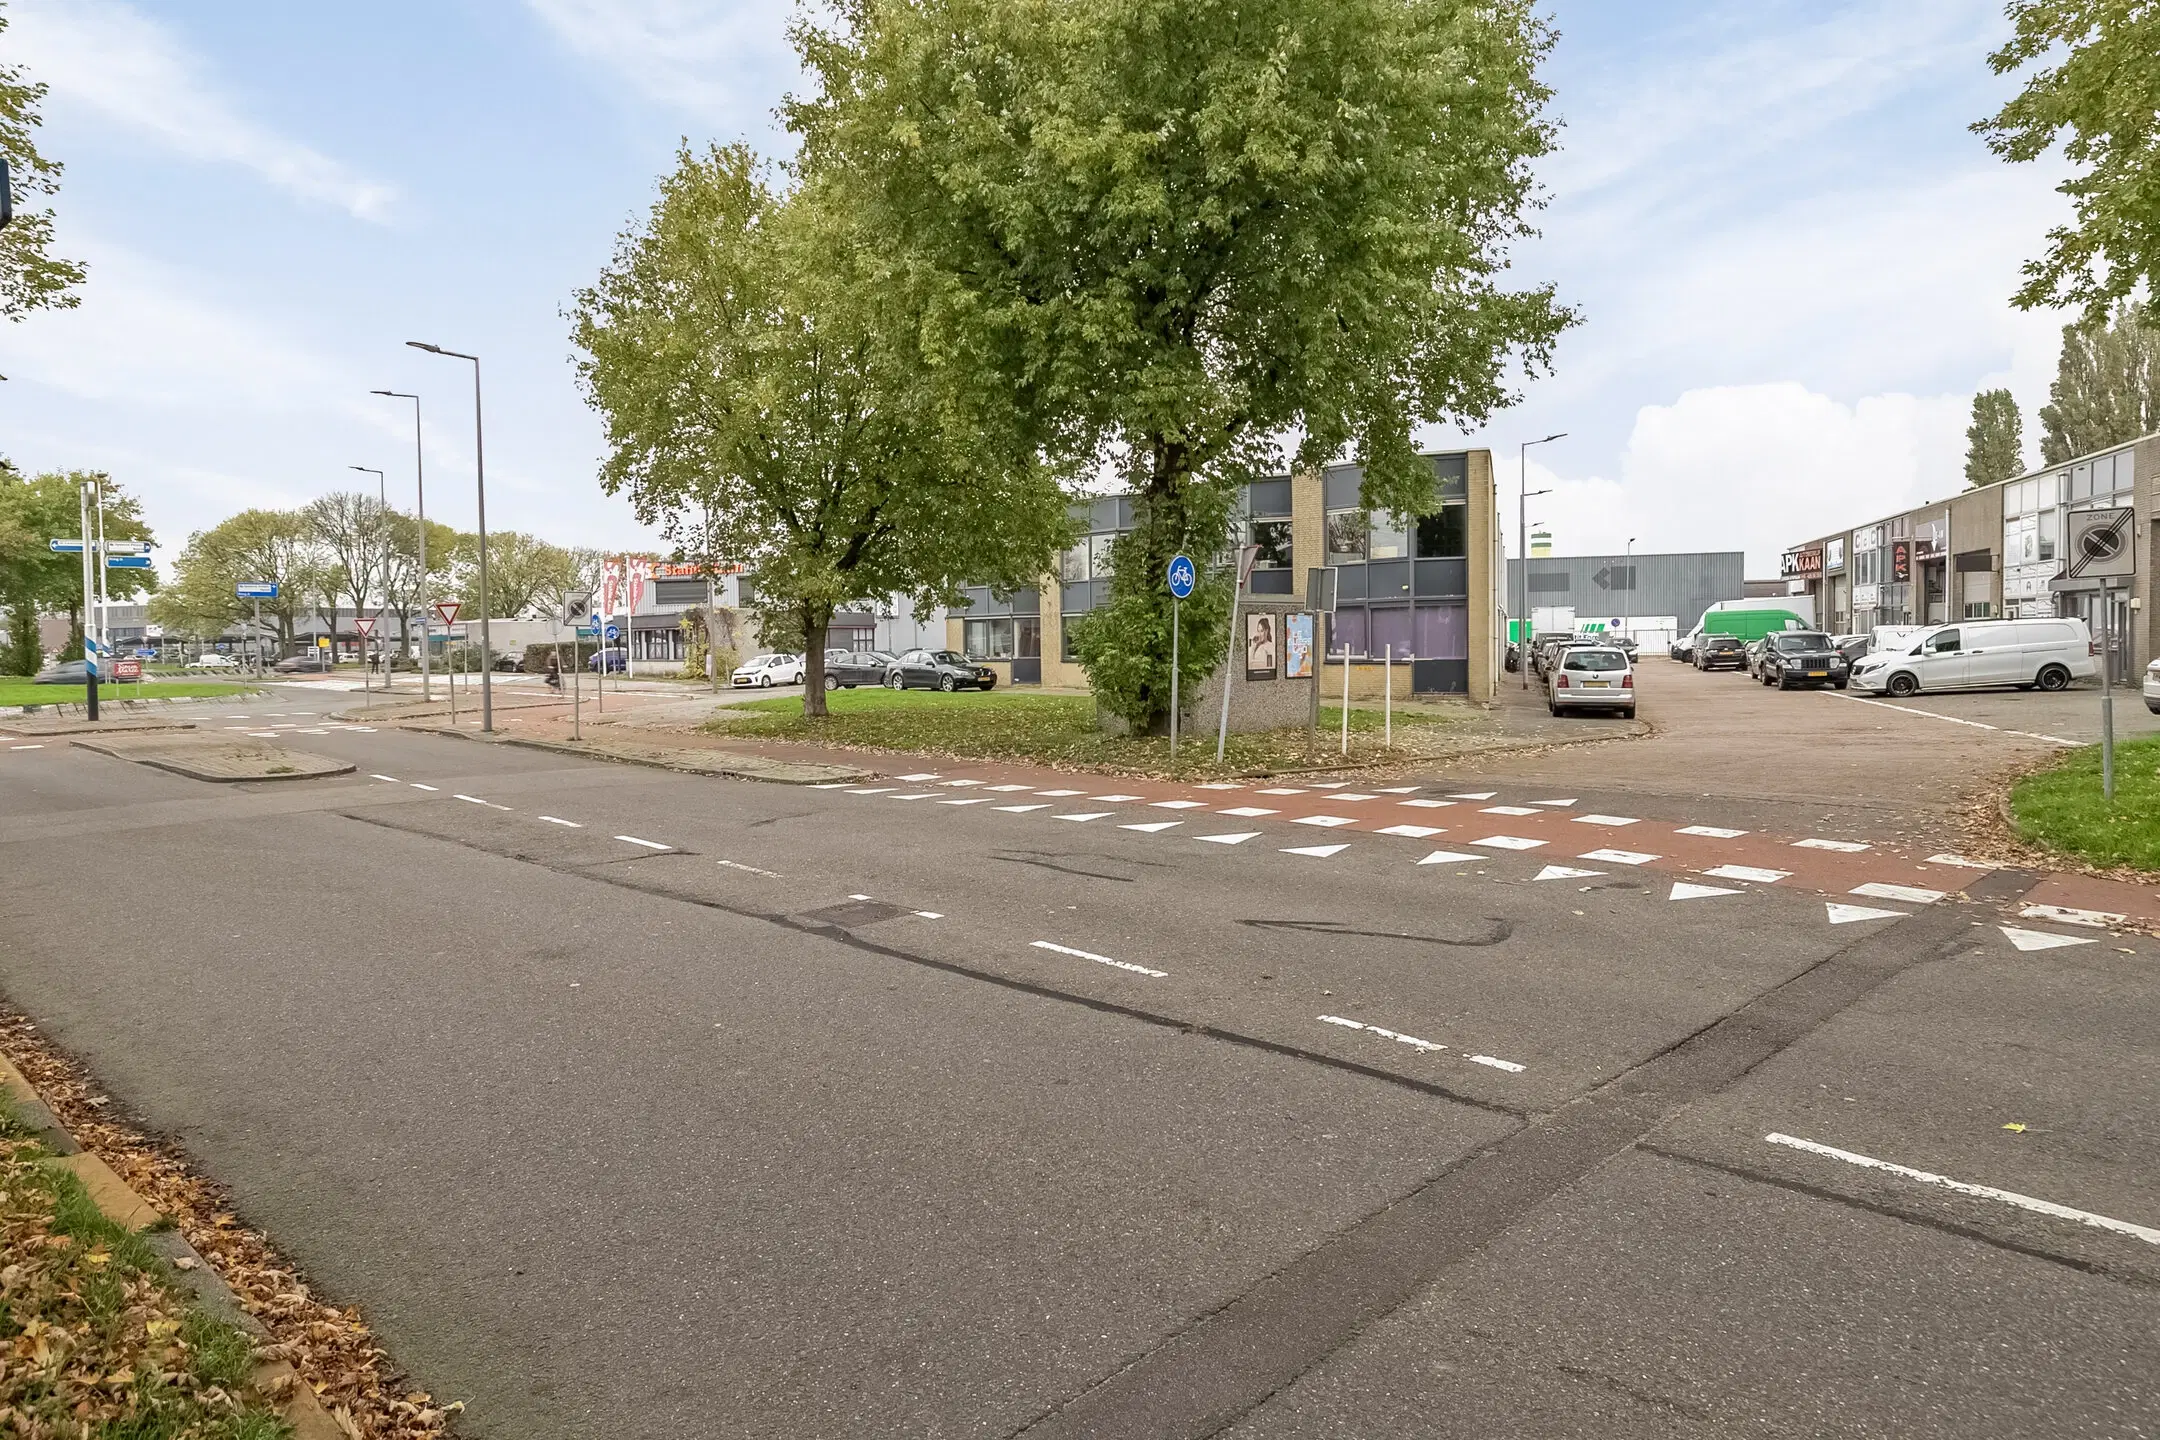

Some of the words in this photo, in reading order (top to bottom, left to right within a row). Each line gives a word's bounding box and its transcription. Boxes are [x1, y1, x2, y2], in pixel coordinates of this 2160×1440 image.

[2086, 512, 2115, 521] ZONE
[1780, 552, 1800, 573] APK
[1799, 555, 1821, 571] KAAN
[1895, 545, 1907, 572] APK
